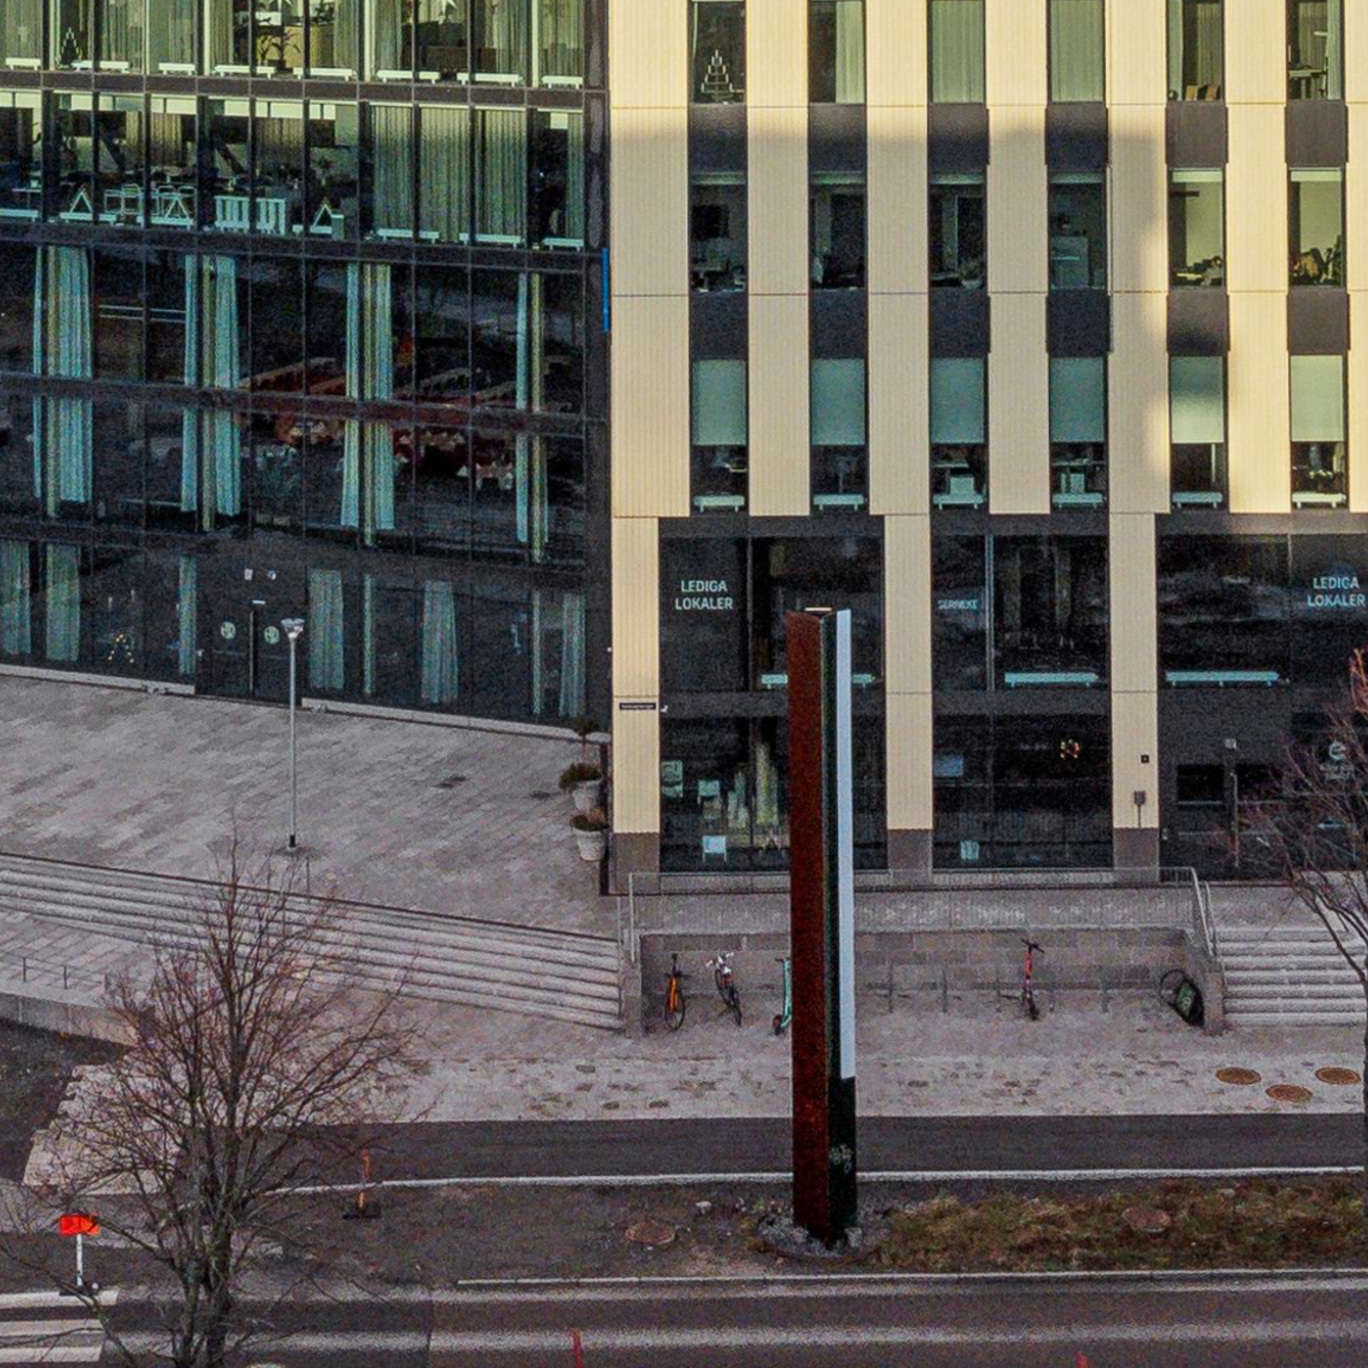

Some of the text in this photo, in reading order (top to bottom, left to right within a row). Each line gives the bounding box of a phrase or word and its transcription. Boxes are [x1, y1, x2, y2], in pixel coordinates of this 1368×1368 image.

[680, 580, 728, 592] LEDIGA
[1313, 576, 1360, 590] LEDIGA
[675, 597, 733, 610] LOKALER
[1307, 594, 1366, 607] LOKALER
